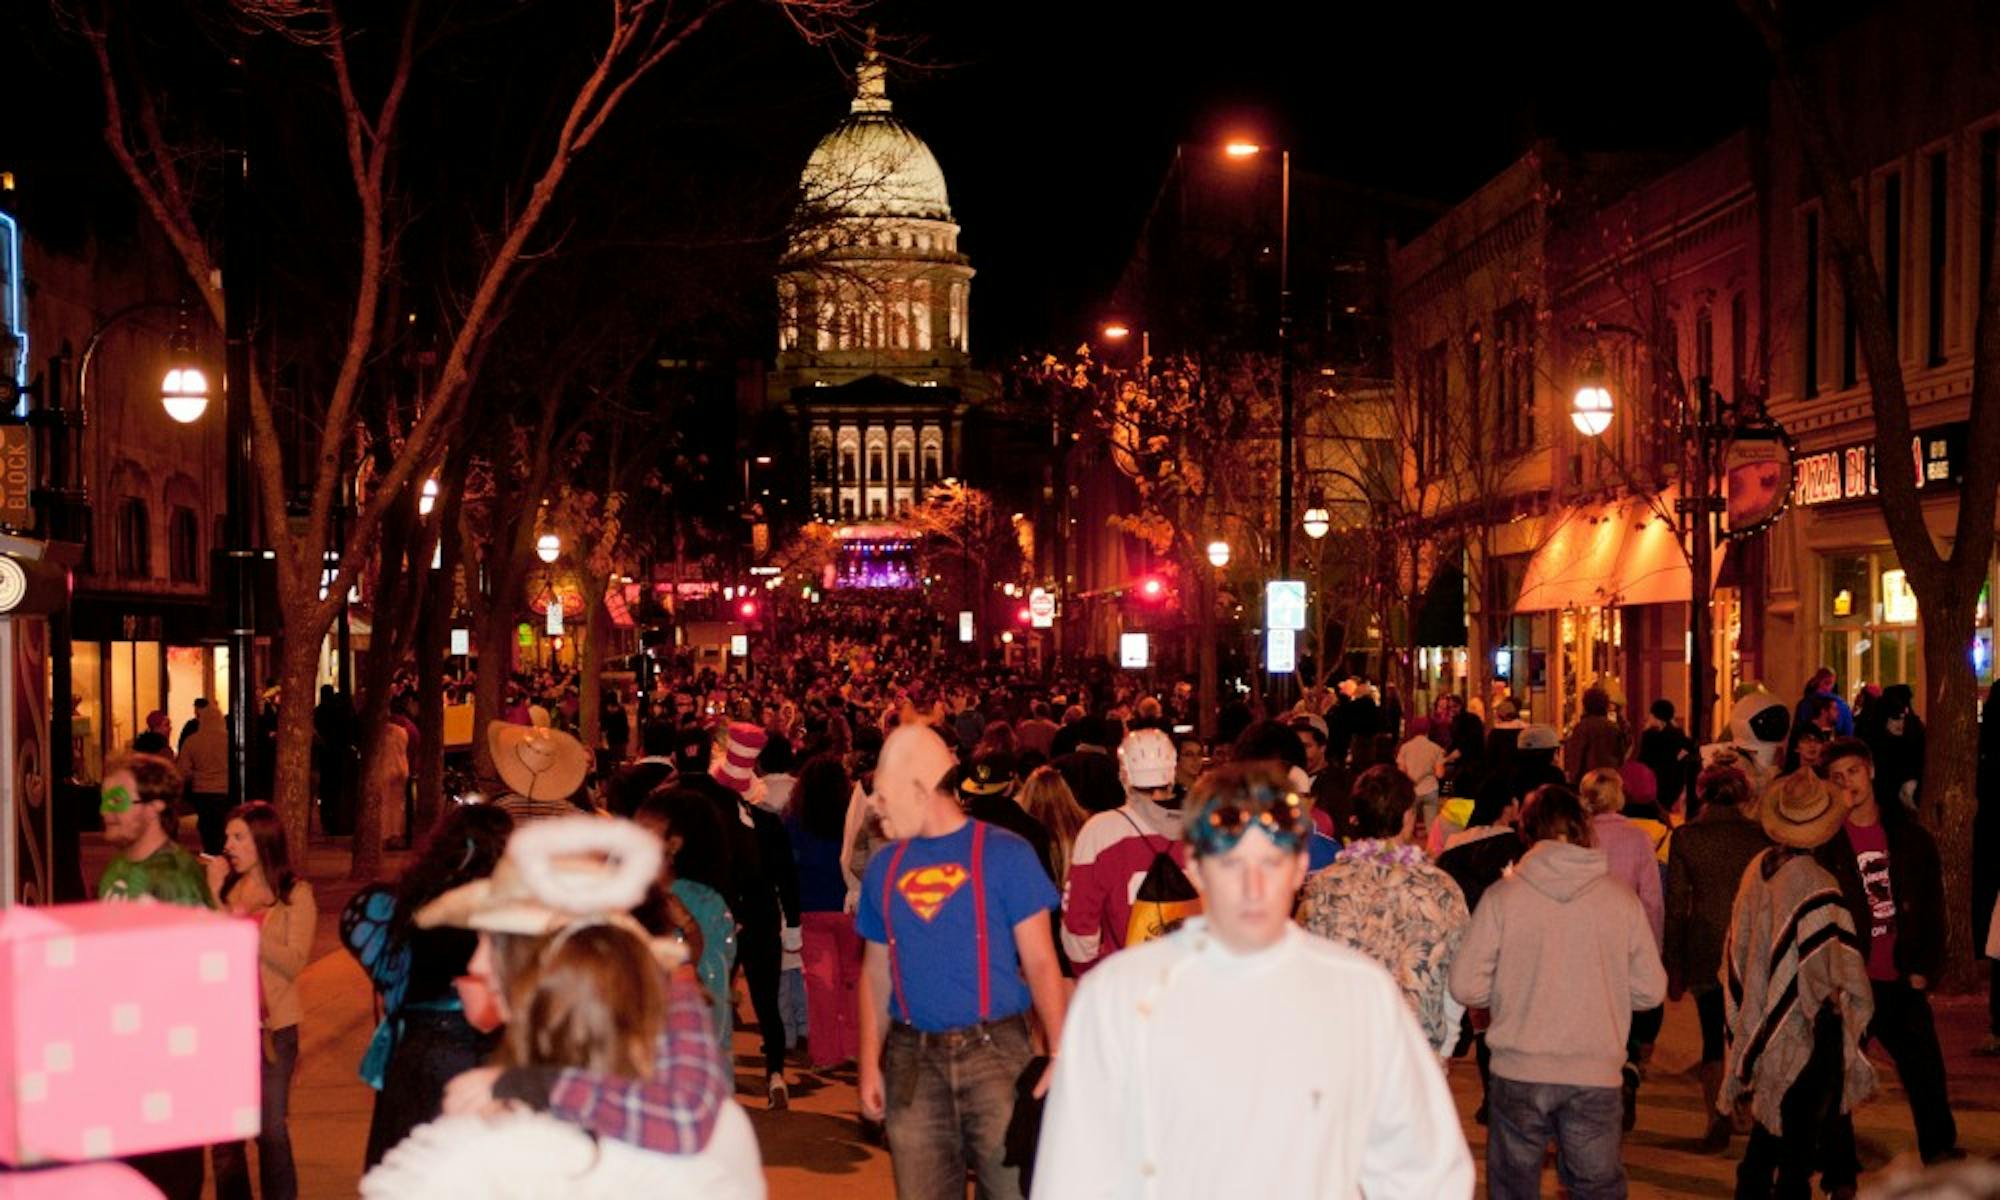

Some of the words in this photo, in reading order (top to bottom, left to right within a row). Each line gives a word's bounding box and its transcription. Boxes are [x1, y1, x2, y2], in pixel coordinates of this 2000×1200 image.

[7, 445, 27, 509] BLOCK
[1796, 452, 1841, 505] PIZZA
[1845, 446, 1865, 497] DI
